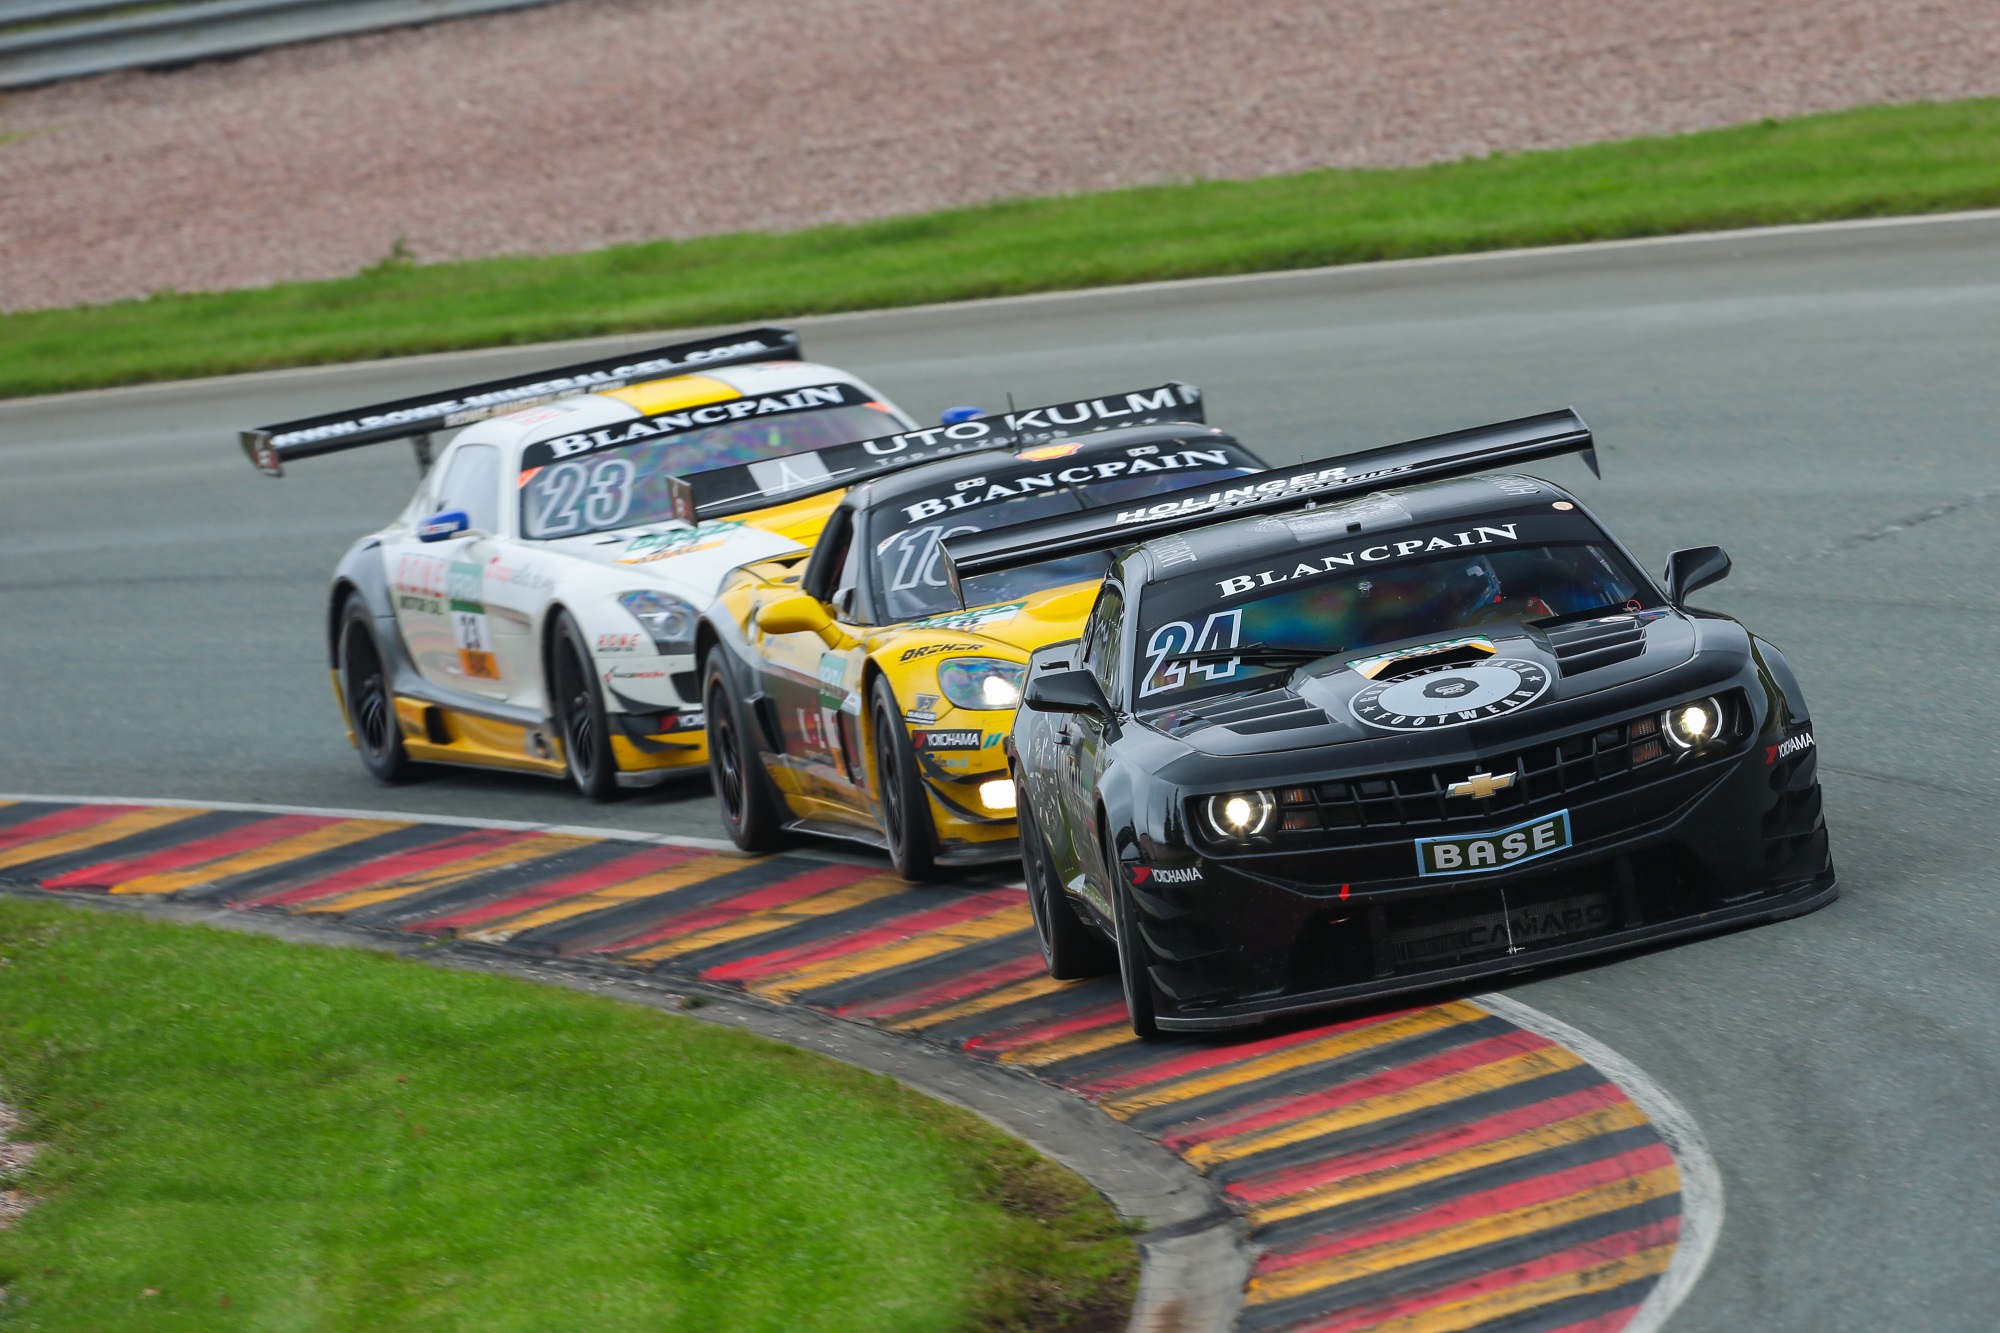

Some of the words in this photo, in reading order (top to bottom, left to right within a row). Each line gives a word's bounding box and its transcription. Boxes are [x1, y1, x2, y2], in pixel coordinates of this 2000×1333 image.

[546, 386, 845, 459] BLANCPAIN
[862, 421, 991, 456] UTO
[1004, 387, 1178, 432] KULM
[535, 459, 636, 536] 23
[902, 450, 1230, 524] BLANCPAIN
[1115, 466, 1347, 524] HOLINGER
[891, 525, 983, 592] 1
[1216, 524, 1518, 598] BLANCPAIN
[899, 643, 985, 662] DREHER
[1139, 608, 1243, 699] 24
[926, 732, 980, 747] YOKOHAMA
[1372, 689, 1536, 727] FOOTWEAR
[1150, 867, 1203, 884] YOKOHAMA
[1432, 821, 1557, 870] BASE
